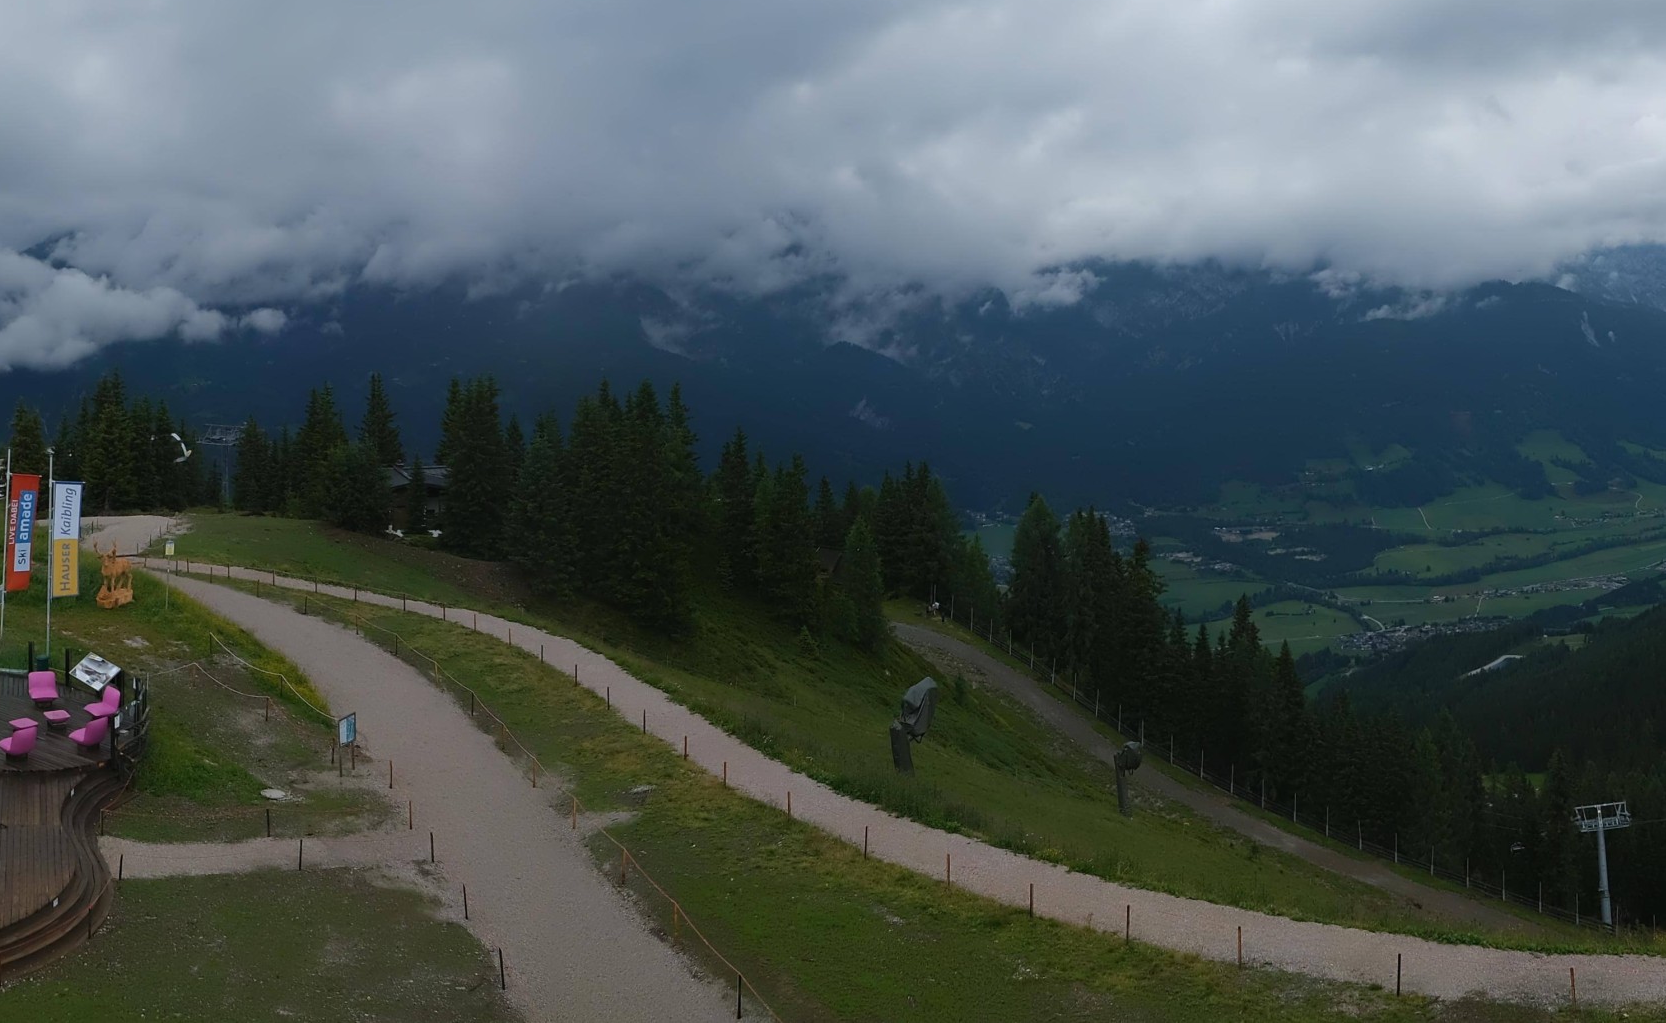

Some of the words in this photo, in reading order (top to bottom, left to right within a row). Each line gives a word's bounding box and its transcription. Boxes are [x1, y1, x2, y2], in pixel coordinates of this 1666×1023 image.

[10, 499, 19, 525] DABEI
[61, 487, 77, 536] Kaibling
[8, 526, 16, 545] LIVE
[18, 549, 26, 565] Ski
[61, 543, 71, 591] HAUSER
